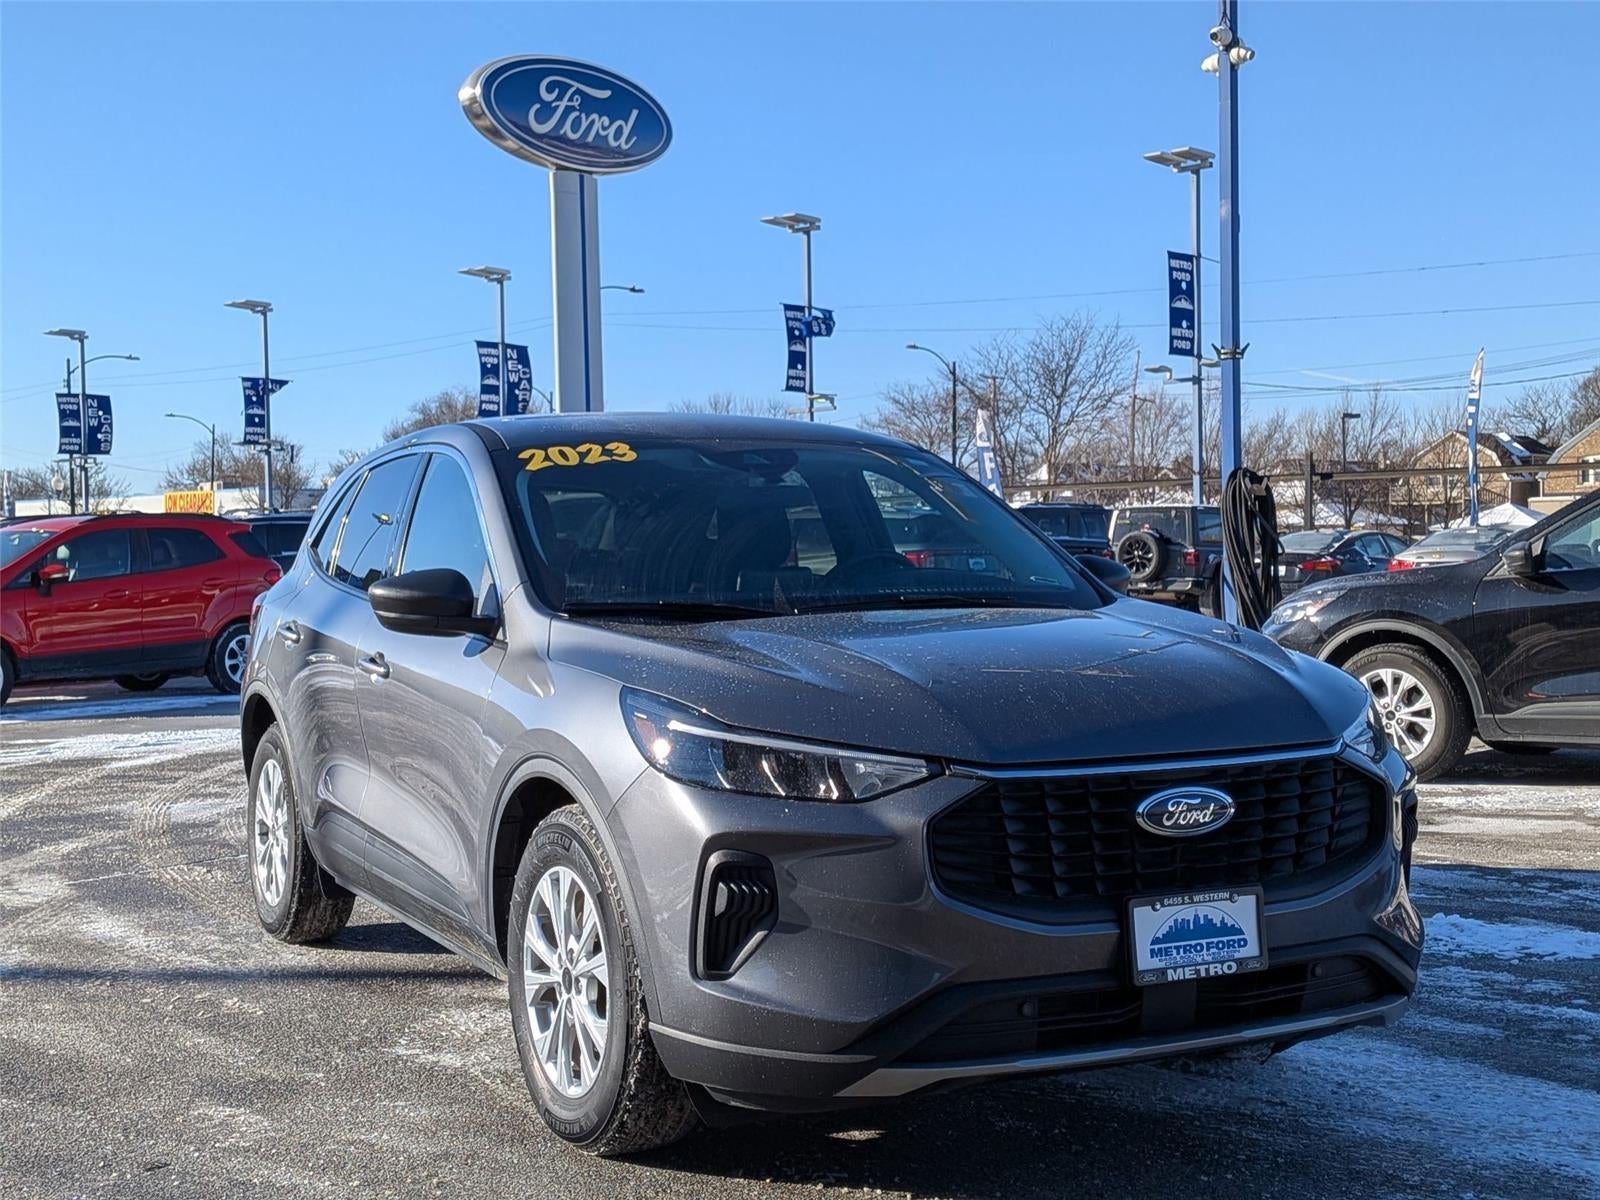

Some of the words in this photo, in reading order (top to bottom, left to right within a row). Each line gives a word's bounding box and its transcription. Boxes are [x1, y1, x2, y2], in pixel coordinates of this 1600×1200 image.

[528, 75, 639, 150] Ford
[1170, 259, 1192, 271] METRO
[1172, 270, 1191, 282] FORD
[1171, 327, 1193, 339] METRO
[479, 347, 499, 356] METRO
[1173, 339, 1191, 350] FORD
[481, 356, 498, 364] FORD
[506, 348, 519, 383] NEW
[480, 393, 500, 403] METRO
[87, 398, 99, 427] NEW
[481, 403, 498, 412] FORD
[100, 414, 111, 451] CARS
[517, 441, 638, 471] 2023
[1162, 797, 1215, 826] Ford
[537, 832, 571, 849] MICHELIN
[1163, 896, 1183, 906] 6455
[1193, 891, 1230, 903] WESTERN
[1167, 961, 1237, 982] METRO
